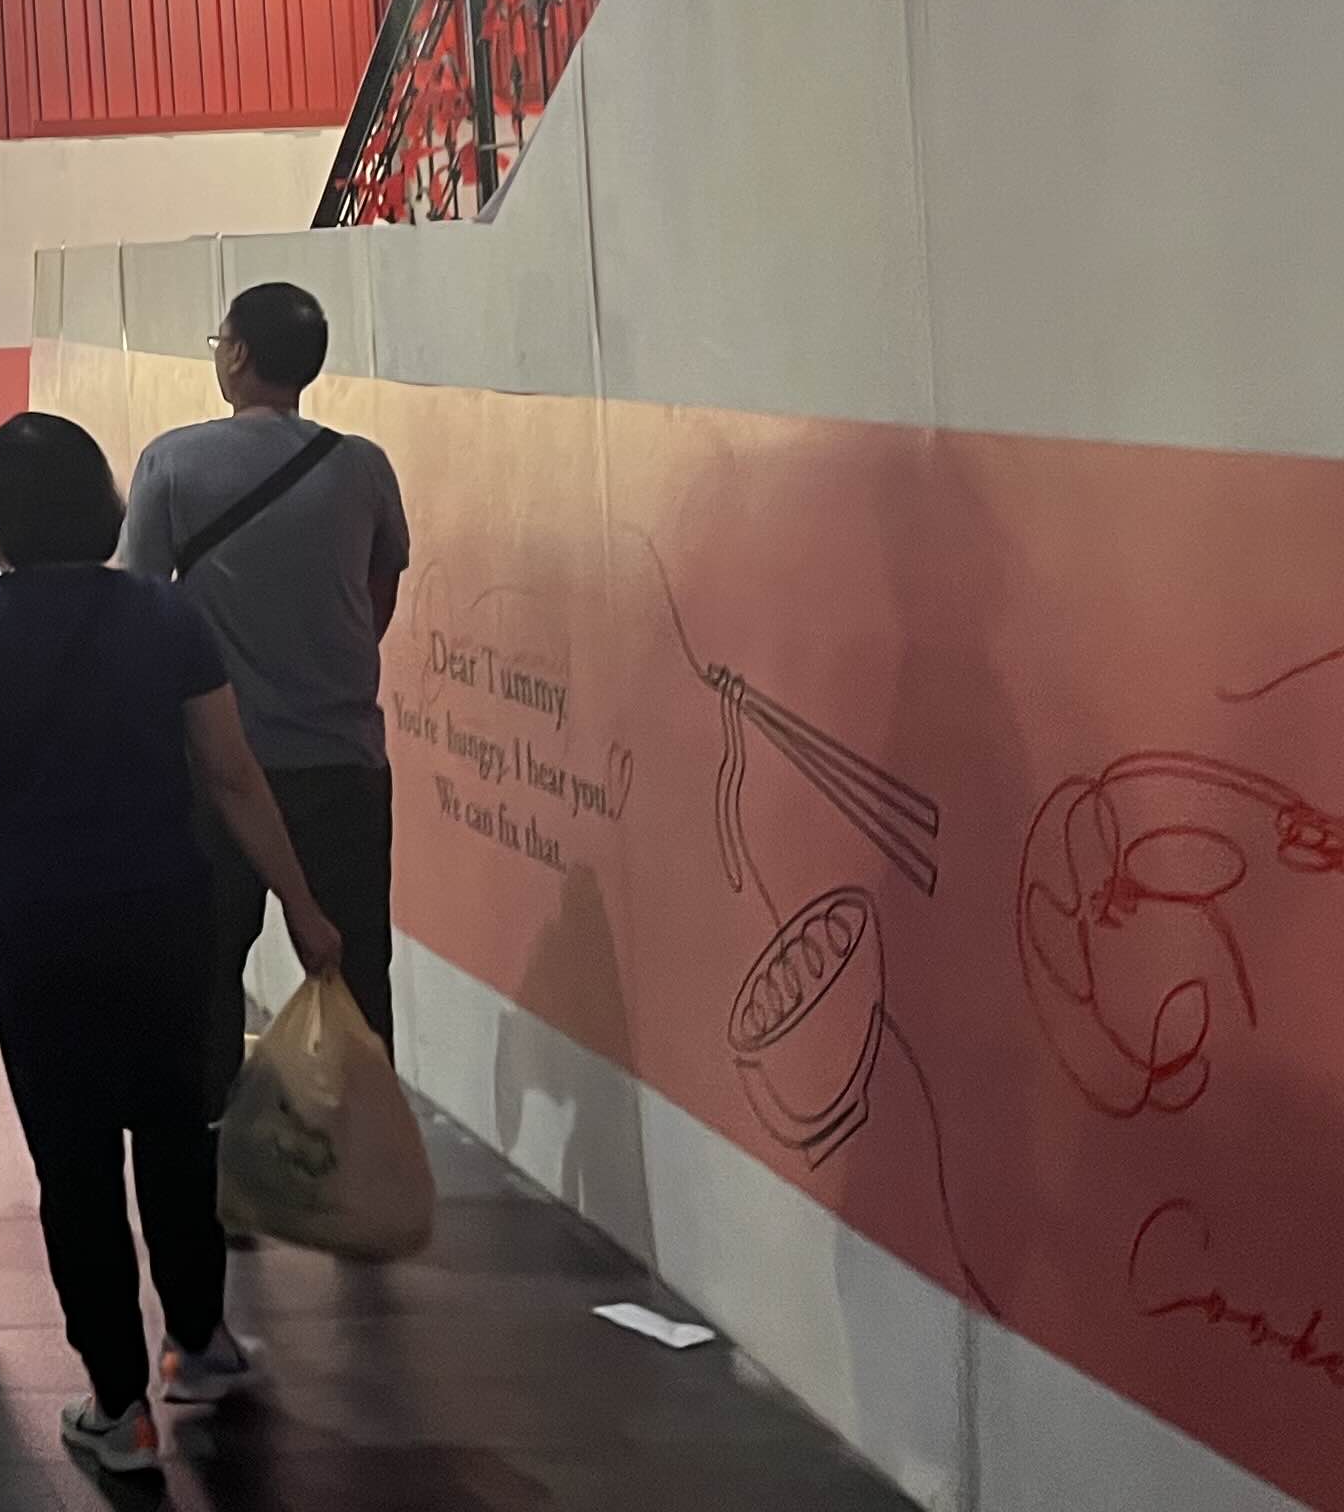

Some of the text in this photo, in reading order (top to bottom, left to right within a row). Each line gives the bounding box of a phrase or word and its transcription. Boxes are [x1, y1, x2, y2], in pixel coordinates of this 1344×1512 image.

[431, 630, 477, 686] Dear
[515, 737, 522, 780] I
[528, 742, 567, 799] hear
[571, 774, 615, 818] you.
[433, 775, 568, 871] We can fix that.
